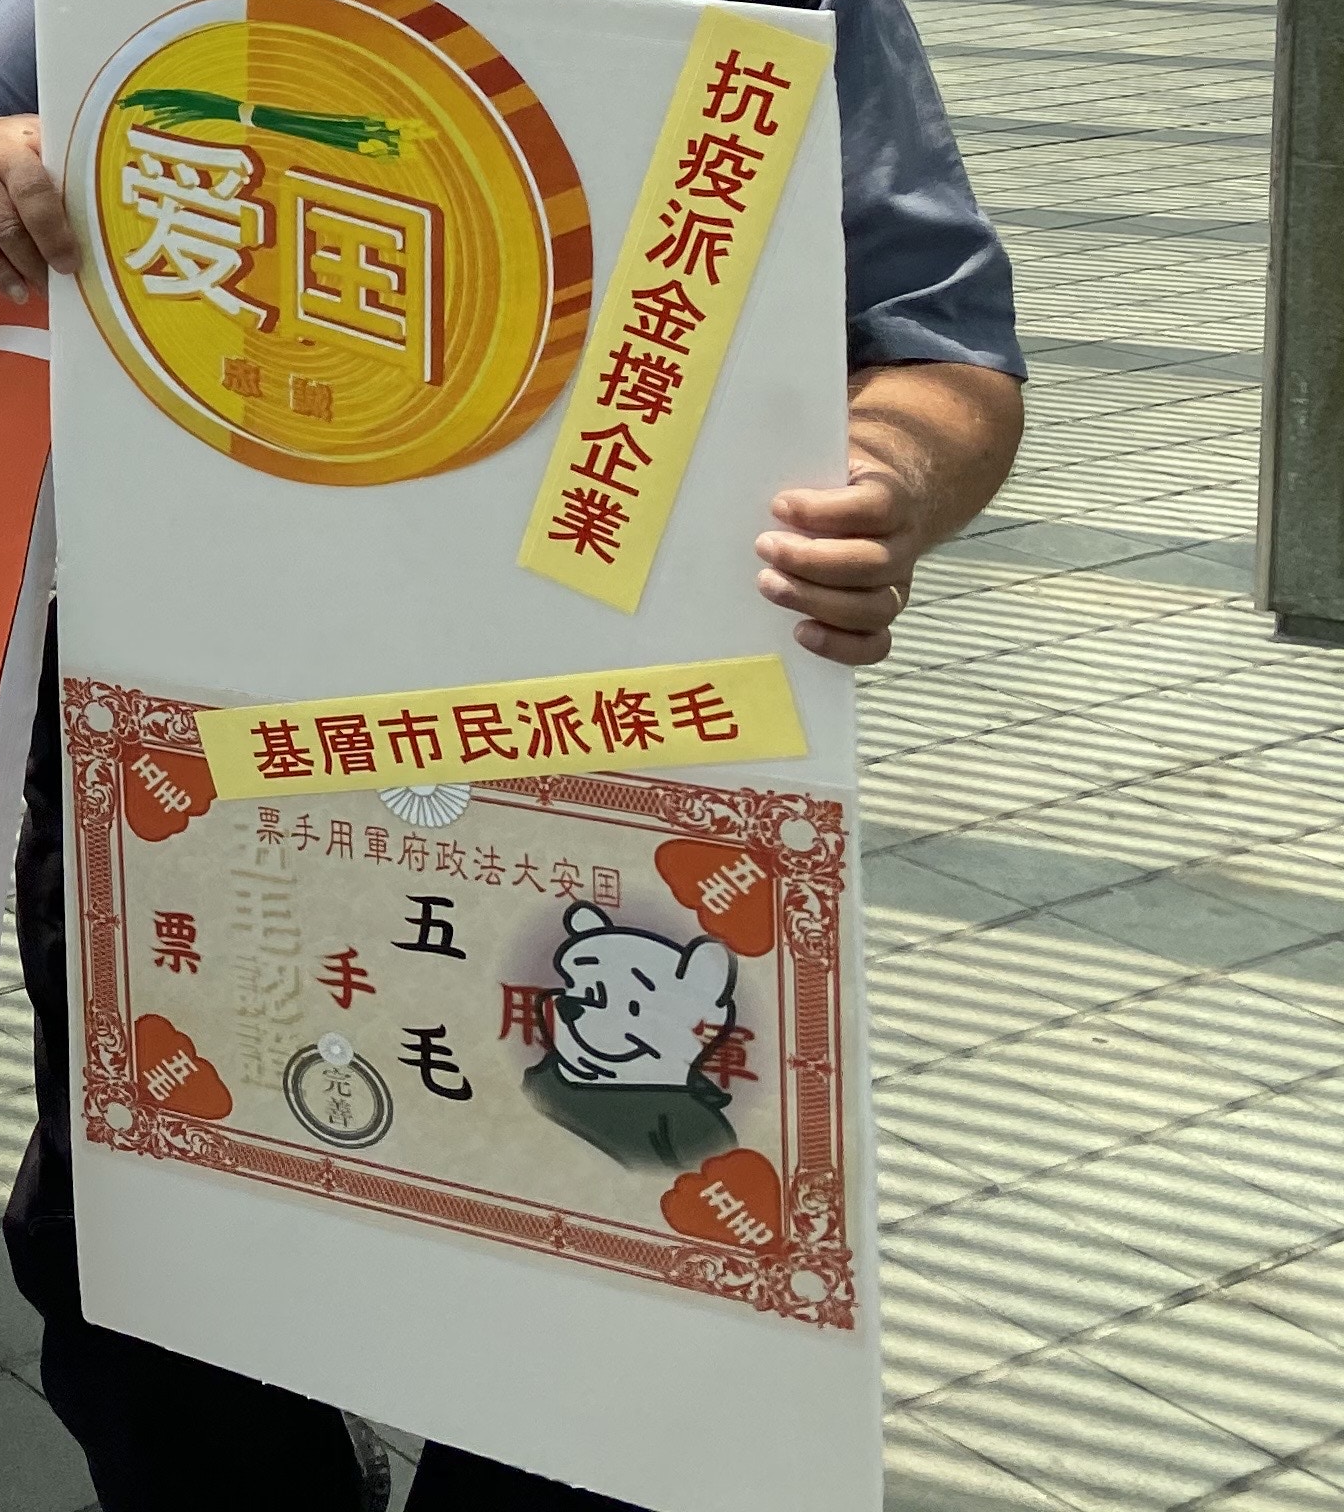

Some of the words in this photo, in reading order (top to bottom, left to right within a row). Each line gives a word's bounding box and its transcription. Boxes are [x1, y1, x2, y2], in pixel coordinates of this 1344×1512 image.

[250, 683, 739, 780] 基層市民派條毛
[131, 753, 192, 813] 五毛
[696, 853, 768, 915] 五毛
[142, 1049, 199, 1101] 五毛
[699, 1180, 774, 1246] 五毛
